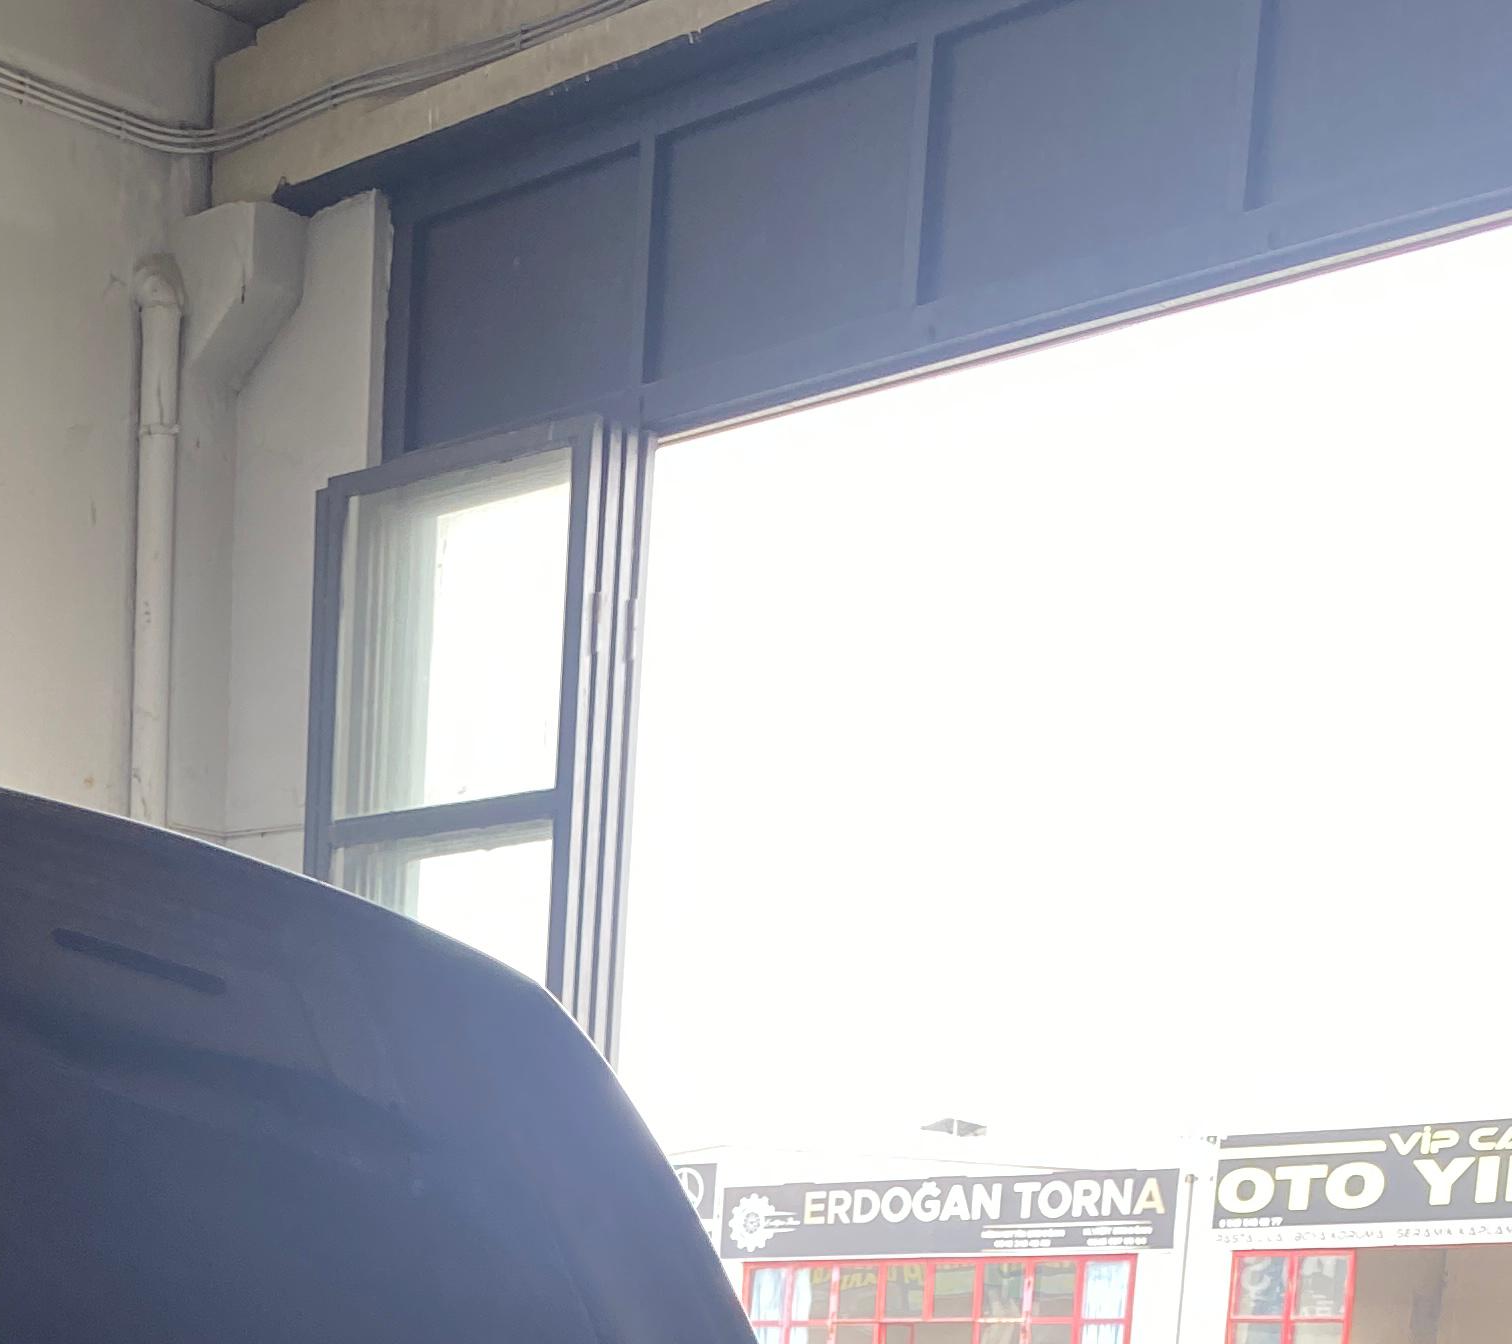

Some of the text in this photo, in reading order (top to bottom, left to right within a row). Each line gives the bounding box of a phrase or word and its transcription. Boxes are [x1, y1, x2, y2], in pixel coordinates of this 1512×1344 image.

[803, 1180, 1003, 1225] ERDOĞAN
[1013, 1177, 1166, 1219] TORNA
[1217, 1155, 1512, 1214] OTO YI
